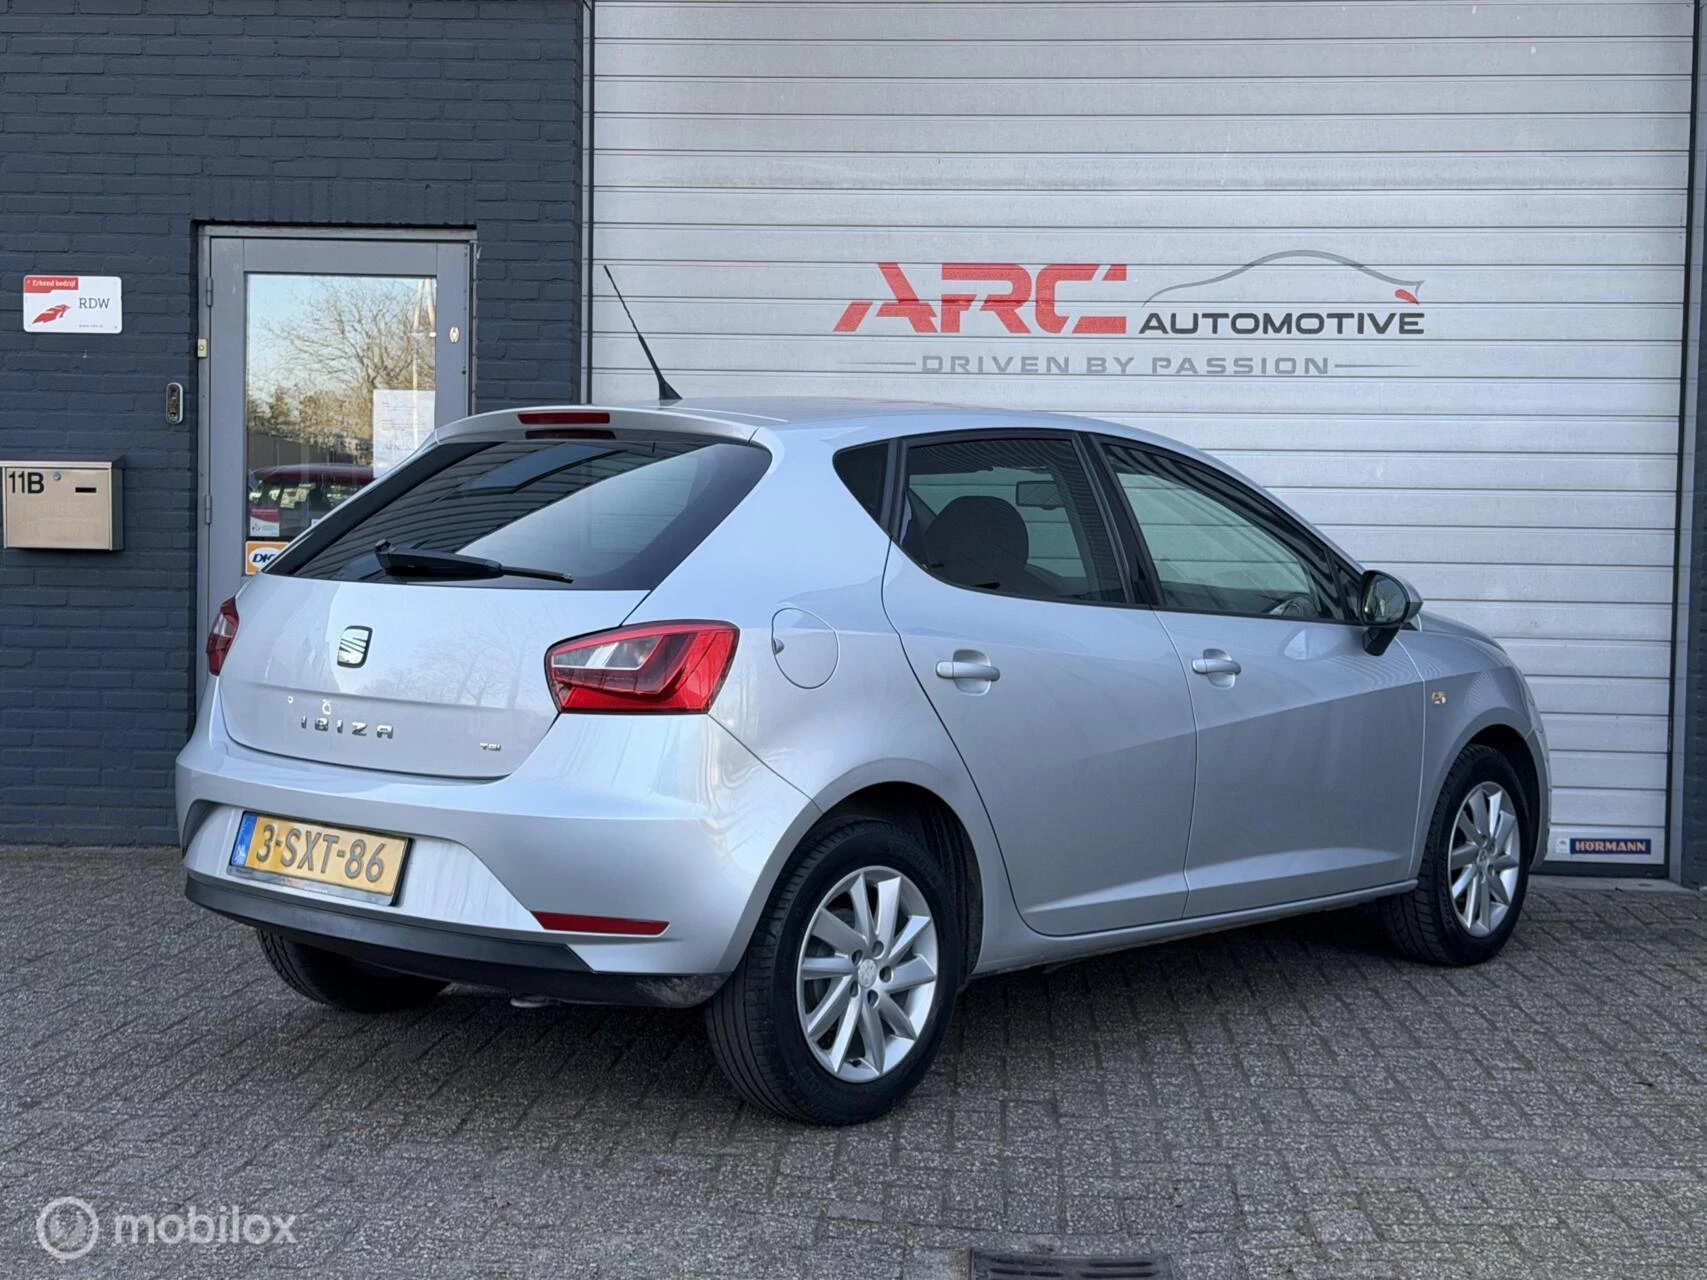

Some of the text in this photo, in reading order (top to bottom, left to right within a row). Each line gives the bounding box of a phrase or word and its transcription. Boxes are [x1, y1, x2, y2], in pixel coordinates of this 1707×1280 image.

[79, 297, 111, 309] RDW
[833, 262, 1425, 334] ARC AUTOMOTIVE
[921, 355, 1329, 375] DRIVEN BY PASSION
[8, 471, 45, 494] 11B
[252, 553, 278, 563] DK
[300, 715, 394, 740] IBIZA
[256, 824, 386, 882] 3-SXT-86
